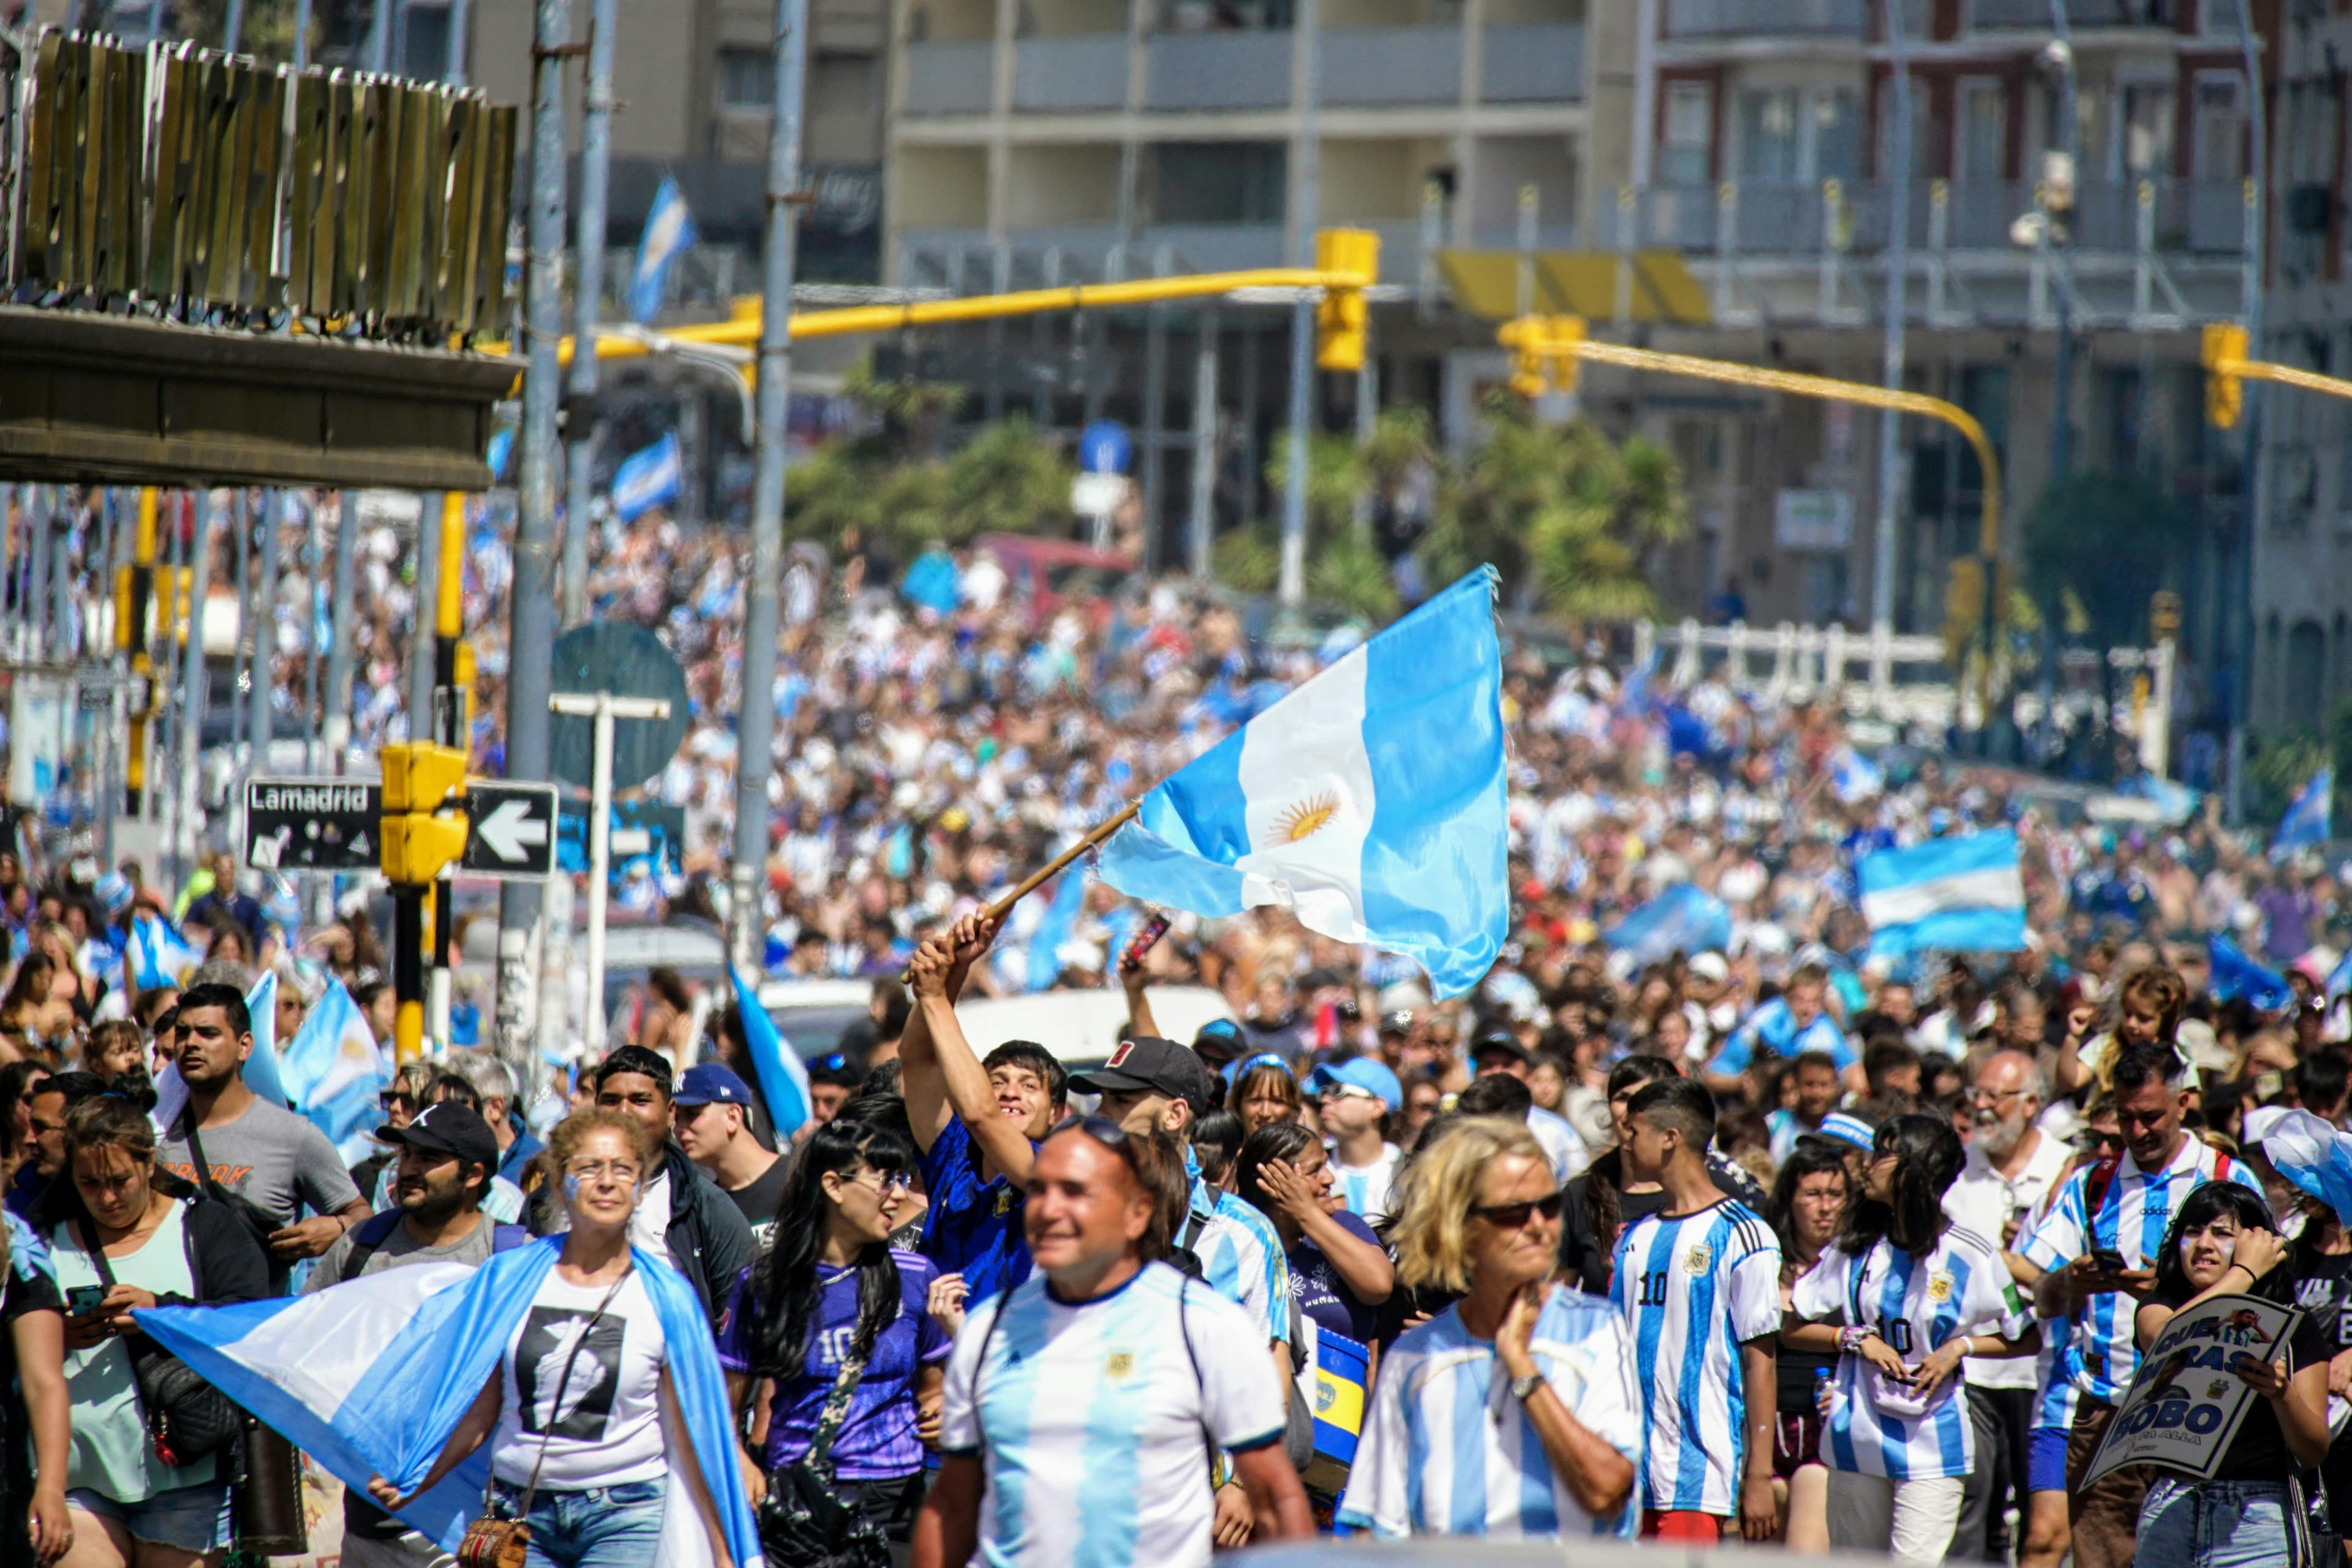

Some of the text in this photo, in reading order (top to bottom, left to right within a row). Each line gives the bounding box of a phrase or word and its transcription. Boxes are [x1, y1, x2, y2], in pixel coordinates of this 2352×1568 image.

[251, 783, 368, 813] Lamadrid
[2139, 1205, 2173, 1216] adidas
[1638, 1271, 1668, 1306] 10
[2154, 1316, 2220, 1355] QUE
[2135, 1345, 2256, 1389] MRAS
[2106, 1400, 2223, 1450] BOBO
[2158, 1430, 2201, 1446] ALLA
